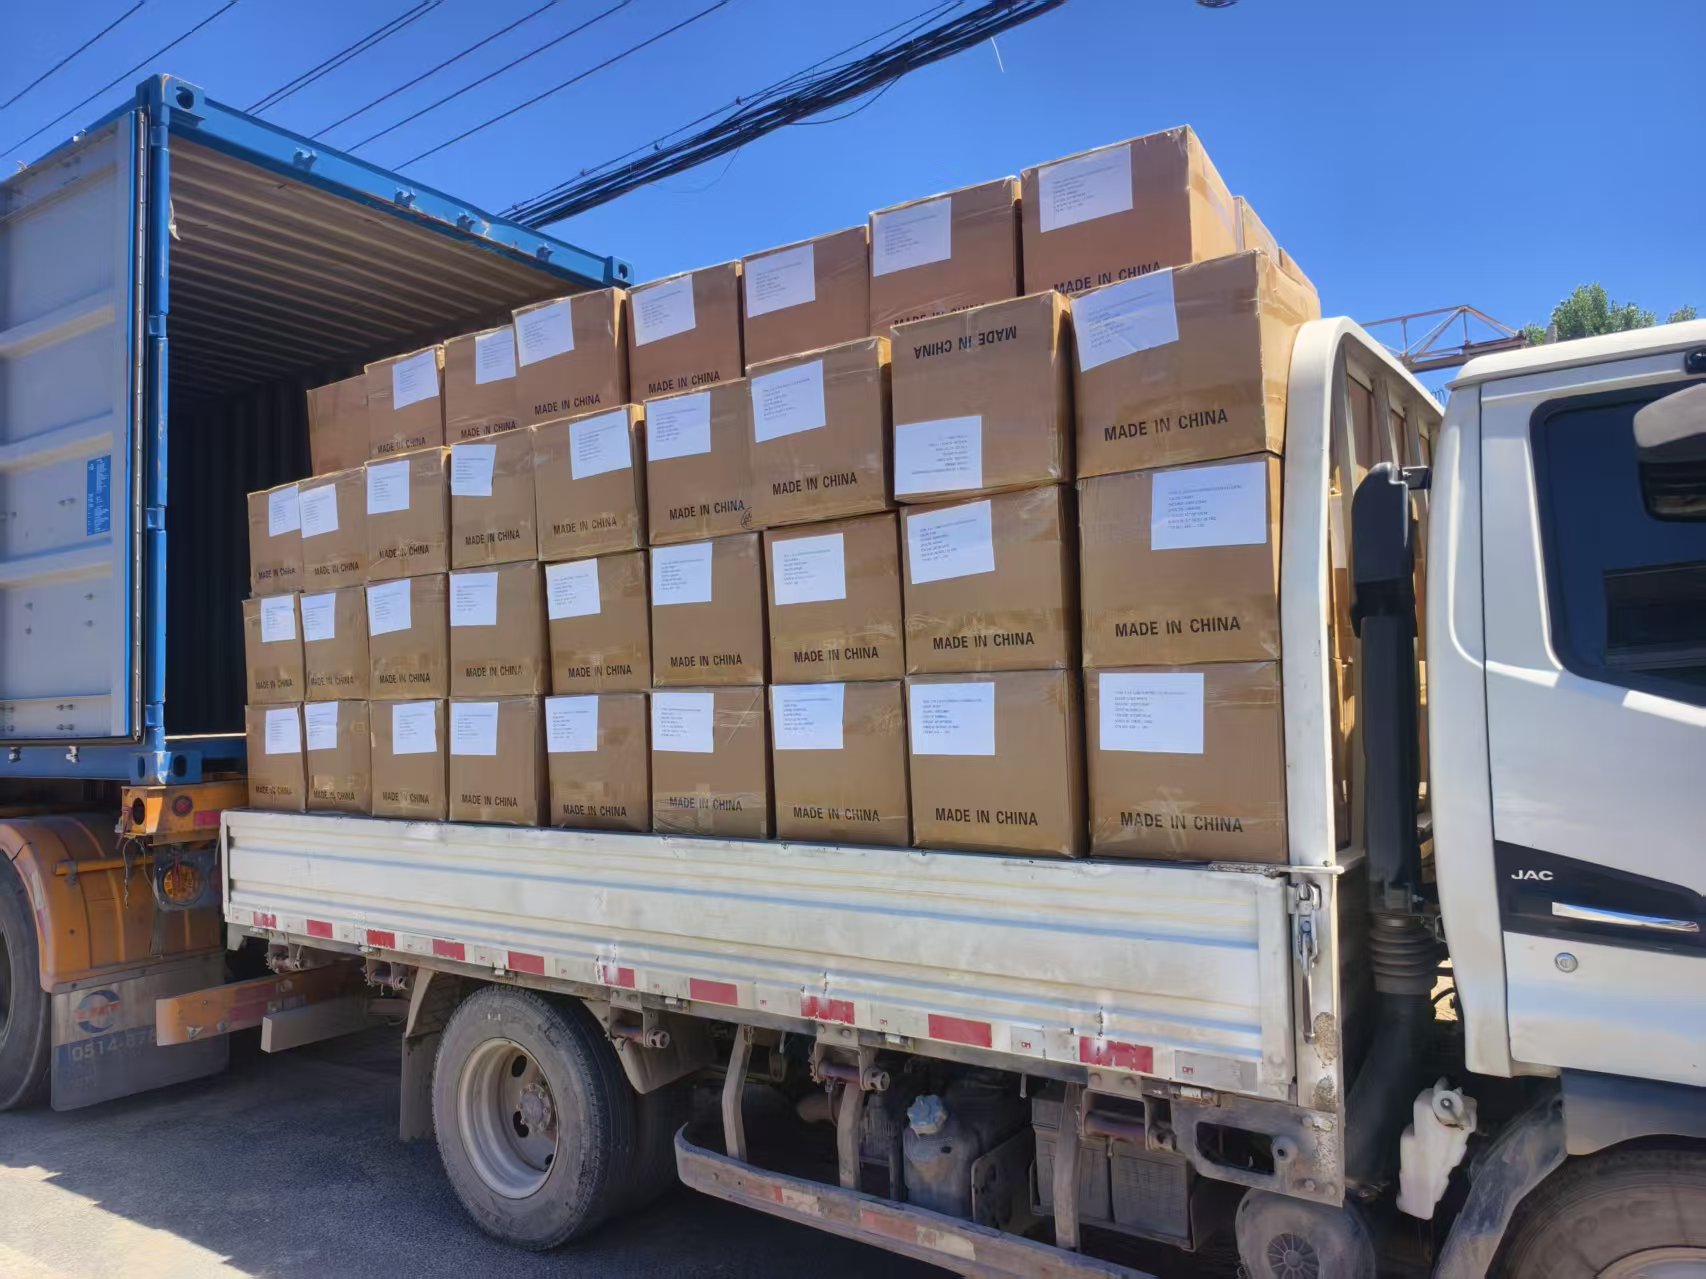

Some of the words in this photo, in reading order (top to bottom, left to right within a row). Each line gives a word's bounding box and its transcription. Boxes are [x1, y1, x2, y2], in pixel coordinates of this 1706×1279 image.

[1054, 276, 1091, 294] MADE
[1098, 270, 1112, 286] IN
[1118, 261, 1161, 281] CHINA
[958, 336, 972, 350] IN
[978, 325, 1017, 346] MADE
[913, 340, 953, 359] CHINA
[648, 380, 674, 394] MADE
[677, 376, 687, 388] IN
[691, 371, 720, 386] CHINA
[534, 403, 558, 415] MADE
[561, 400, 570, 410] IN
[573, 394, 600, 407] CHINA
[461, 426, 480, 438] MADE
[483, 425, 491, 434] IN
[493, 420, 516, 432] CHINA
[1104, 420, 1148, 441] MADE
[1154, 417, 1170, 433] IN
[1178, 408, 1228, 430] CHINA
[772, 481, 803, 495] MADE
[806, 477, 818, 491] IN
[823, 472, 857, 488] CHINA
[669, 507, 696, 521] MADE
[700, 504, 710, 516] IN
[714, 499, 745, 514] CHINA
[553, 522, 577, 536] MADE
[579, 520, 588, 531] IN
[591, 516, 617, 530] CHINA
[465, 535, 484, 545] MADE
[487, 533, 495, 543] IN
[497, 529, 520, 541] CHINA
[408, 544, 429, 556] CHINA
[314, 565, 330, 575] MADE
[339, 562, 359, 572] CHINA
[1115, 621, 1158, 637] MADE
[1166, 620, 1182, 634] IN
[1190, 616, 1241, 633] CHINA
[933, 636, 968, 650] MADE
[973, 634, 987, 648] IN
[993, 631, 1034, 647] CHINA
[670, 654, 696, 668] MADE
[699, 655, 709, 666] IN
[713, 653, 742, 666] CHINA
[794, 650, 825, 663] MADE
[828, 649, 840, 661] IN
[844, 646, 879, 661] CHINA
[379, 674, 397, 684] MADE
[408, 672, 430, 683] CHINA
[466, 667, 486, 677] MADE
[489, 666, 497, 676] IN
[500, 664, 523, 676] CHINA
[568, 666, 592, 678] MADE
[594, 666, 602, 677] IN
[606, 664, 632, 676] CHINA
[382, 791, 399, 801] MADE
[409, 794, 429, 804] CHINA
[462, 794, 481, 805] MADE
[484, 796, 492, 805] IN
[495, 796, 518, 807] CHINA
[669, 796, 695, 809] MADE
[699, 798, 709, 809] IN
[712, 799, 742, 811] CHINA
[563, 804, 586, 816] MADE
[587, 805, 597, 816] IN
[600, 805, 627, 817] CHINA
[793, 806, 824, 820] MADE
[828, 807, 839, 819] IN
[844, 808, 880, 822] CHINA
[935, 807, 971, 823] MADE
[976, 809, 990, 824] IN
[995, 810, 1038, 826] CHINA
[1120, 812, 1163, 829] MADE
[1171, 814, 1187, 830] IN
[1193, 815, 1243, 833] CHINA
[1511, 869, 1554, 881] JAC
